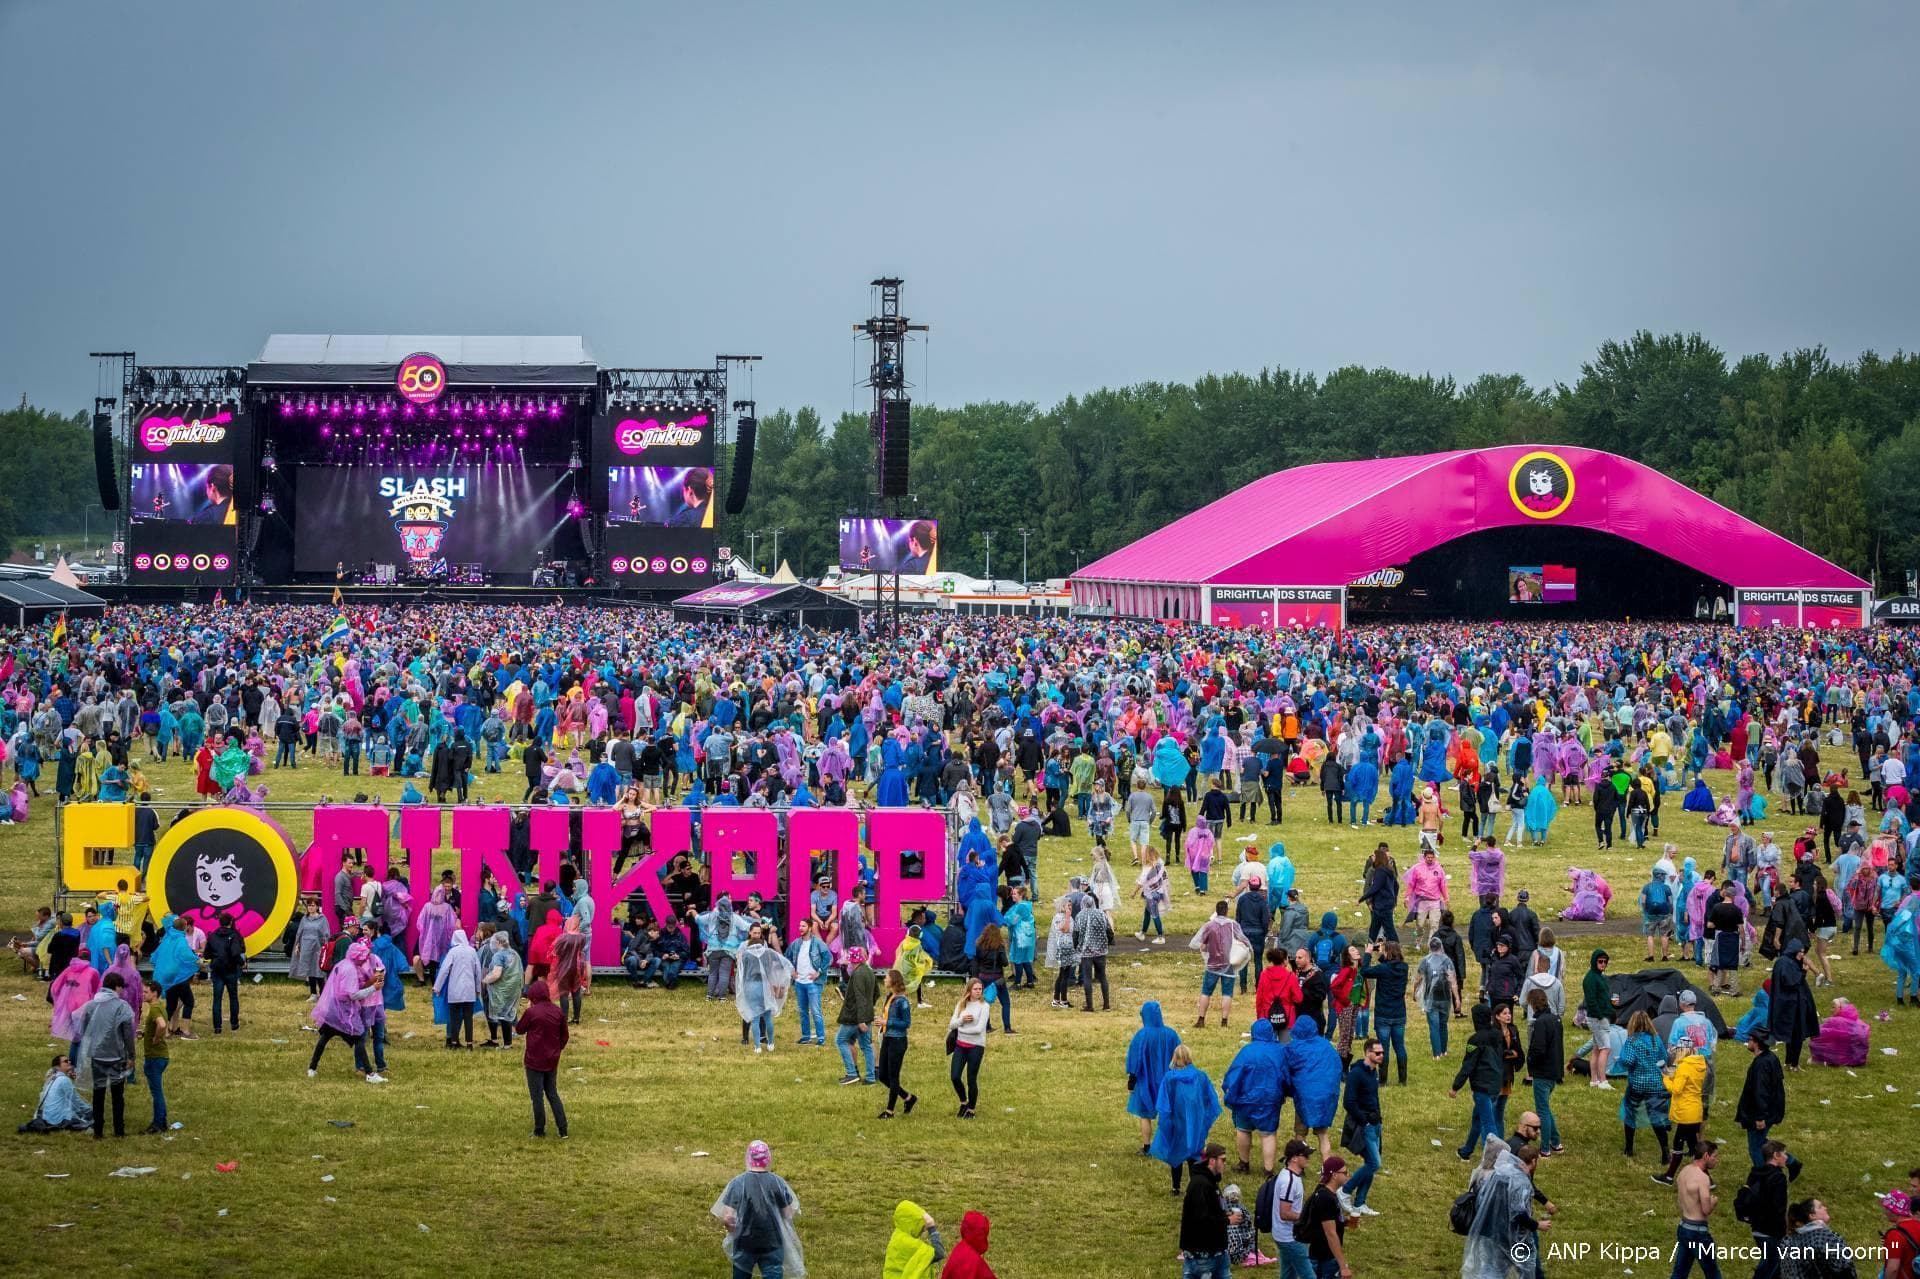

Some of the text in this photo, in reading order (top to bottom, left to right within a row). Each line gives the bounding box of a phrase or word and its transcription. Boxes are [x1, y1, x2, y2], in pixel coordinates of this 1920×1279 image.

[402, 365, 441, 392] 50
[379, 477, 465, 497] SLASH
[1216, 589, 1332, 600] BRIGHTLANDS STAGE
[1743, 592, 1853, 603] BRIGHTLANDS STAGE
[1891, 602, 1920, 614] BAR
